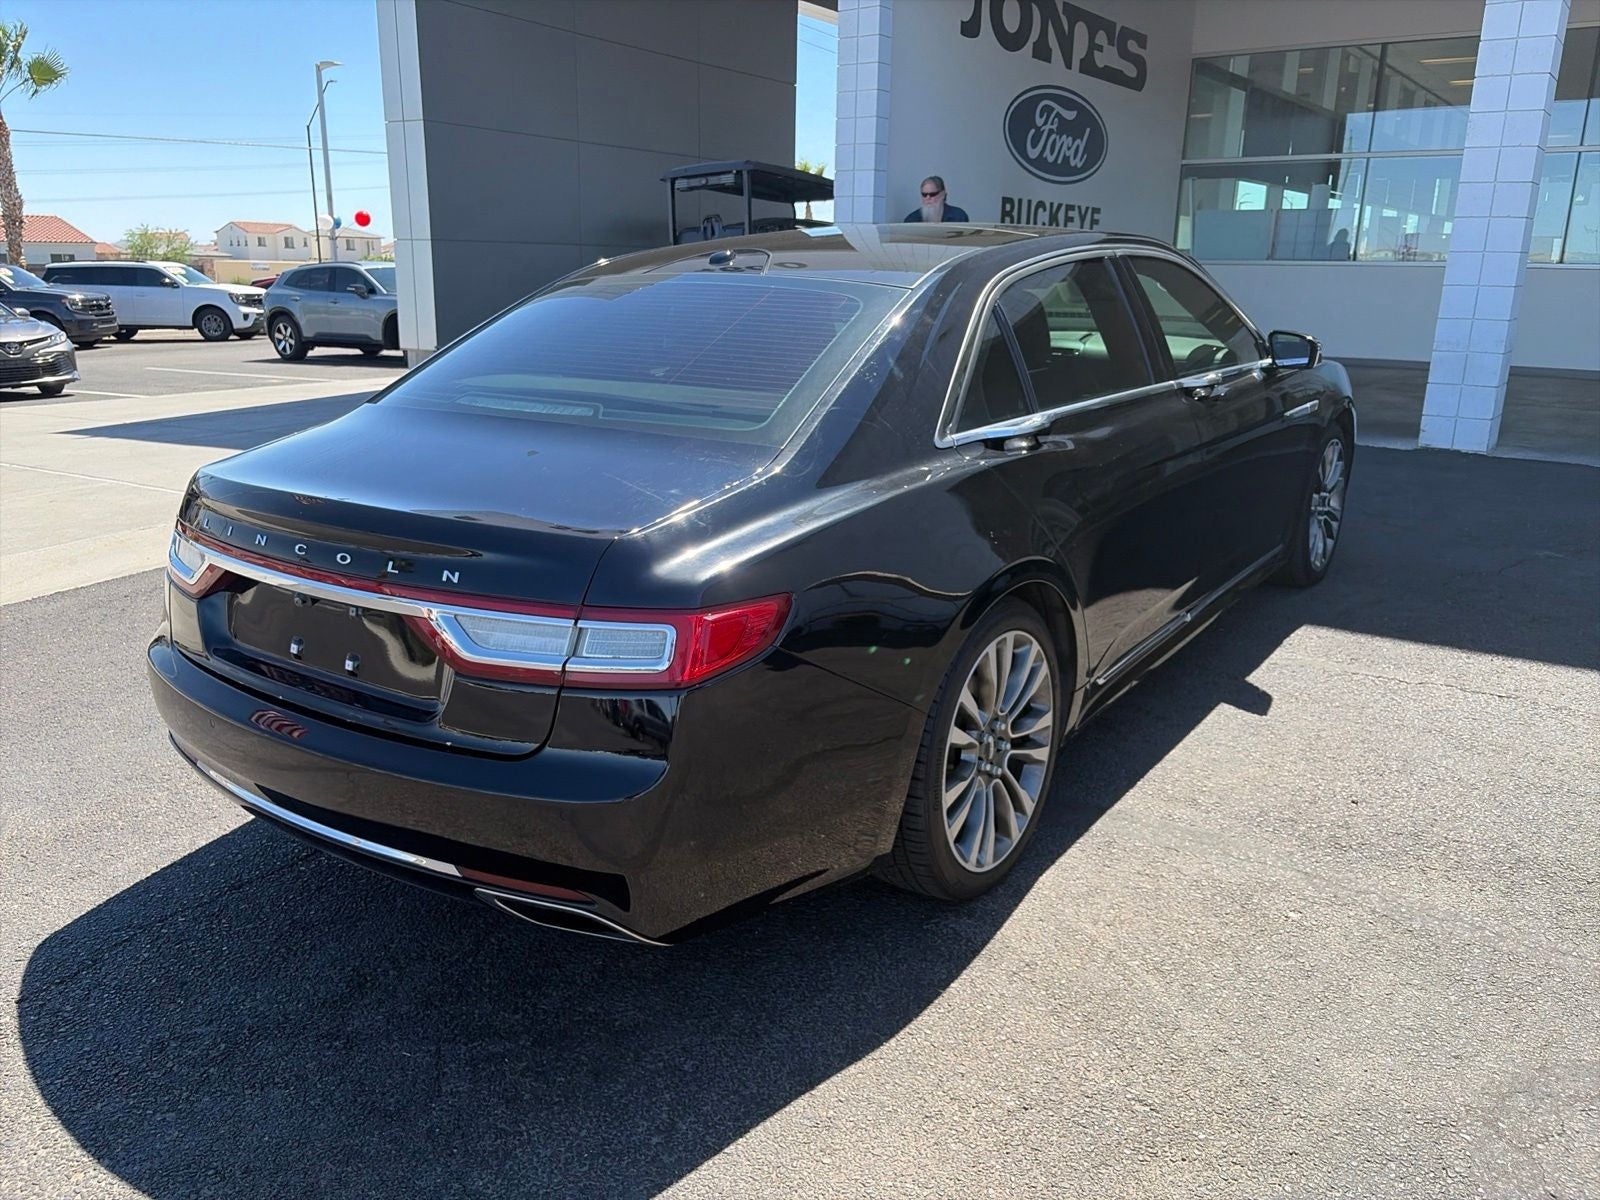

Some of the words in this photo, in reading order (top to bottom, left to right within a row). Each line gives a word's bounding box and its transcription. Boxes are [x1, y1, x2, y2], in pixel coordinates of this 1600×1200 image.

[960, 0, 1148, 92] JONES
[1026, 100, 1090, 168] Ford
[1000, 196, 1102, 230] BUCKEYE
[203, 518, 460, 584] LINCOLN
